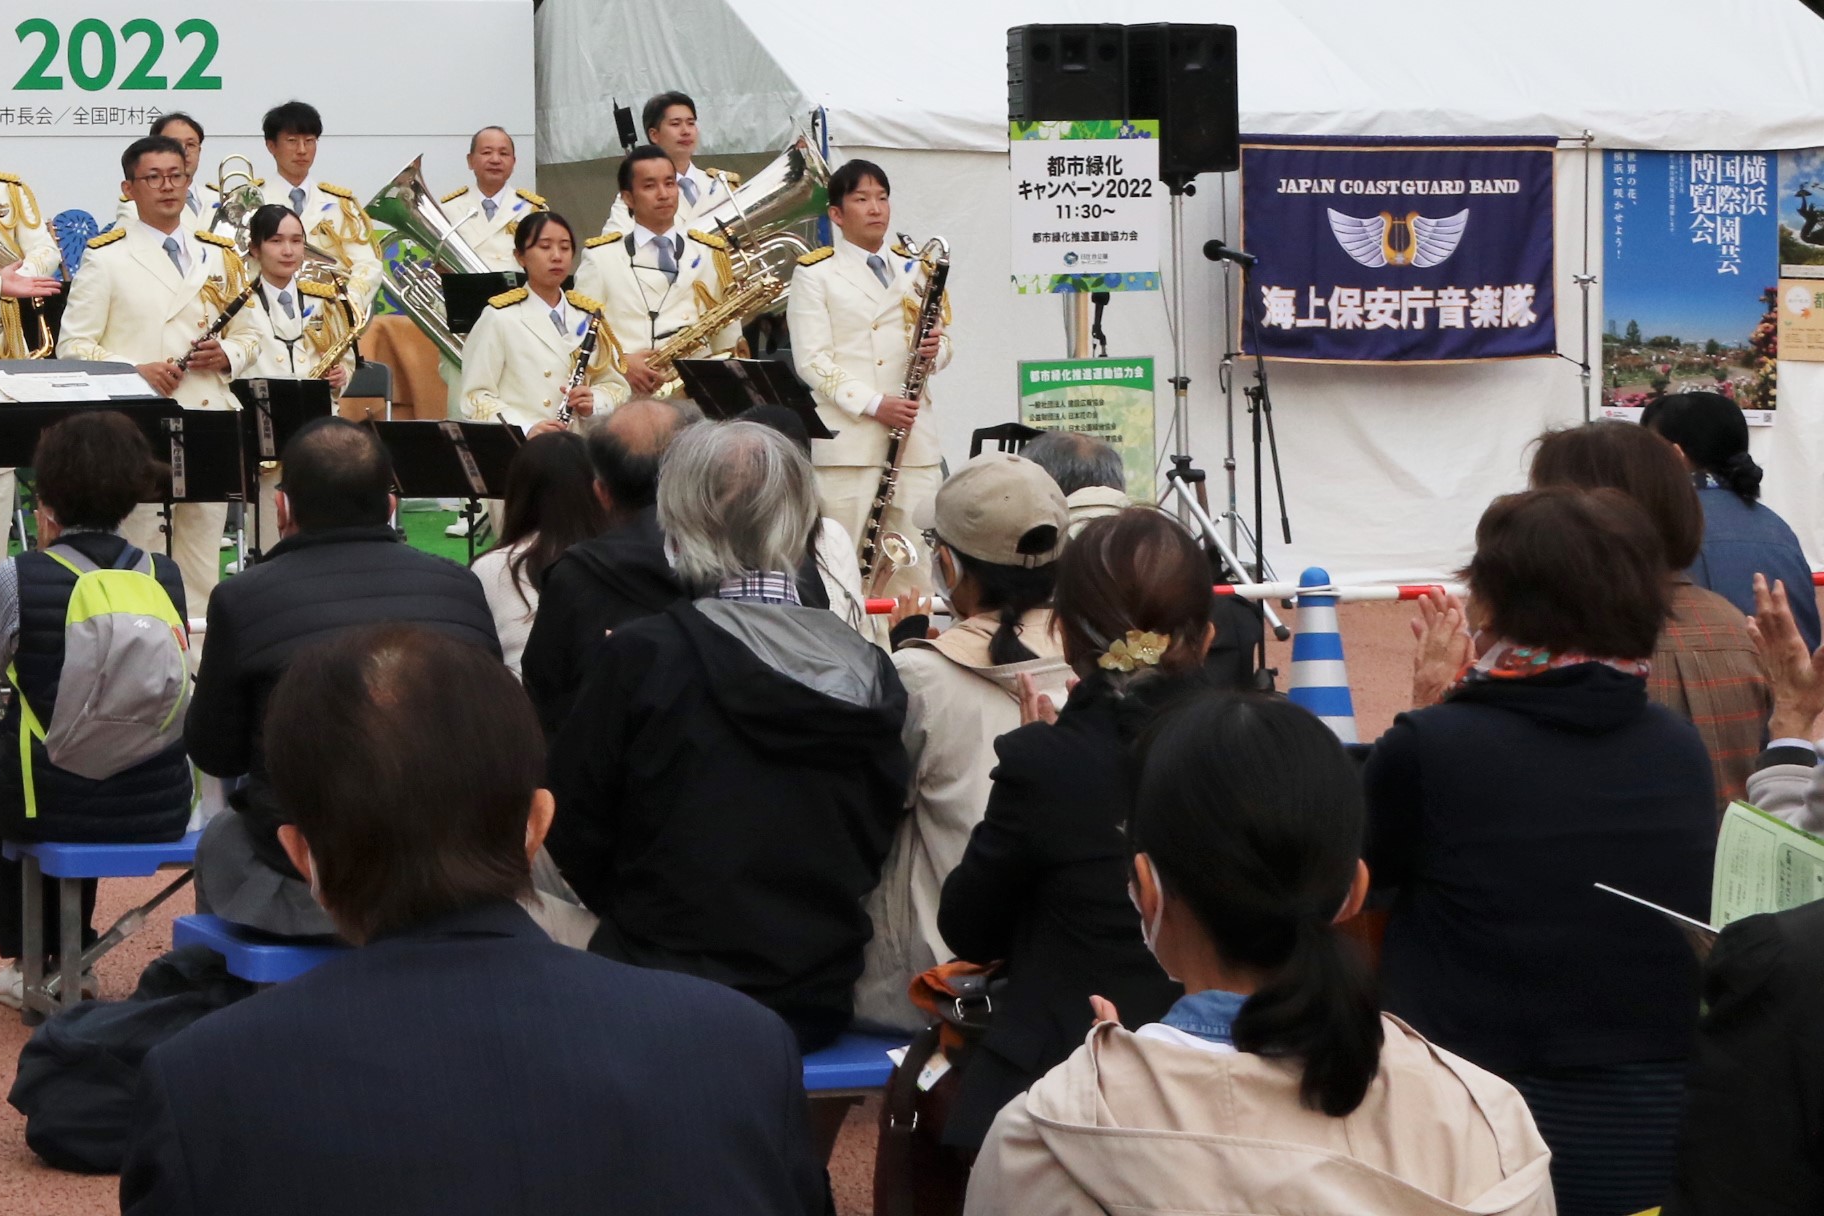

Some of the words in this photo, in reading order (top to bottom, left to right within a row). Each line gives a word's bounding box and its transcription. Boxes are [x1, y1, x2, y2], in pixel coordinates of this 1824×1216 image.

[12, 17, 223, 92] 2022
[1047, 155, 1123, 177] 都市緑化
[1018, 178, 1152, 201] キャンペーン2022
[1277, 179, 1336, 195] JAPAN
[1469, 179, 1520, 195] BAND
[1689, 152, 1716, 245] 博覧会
[1740, 154, 1768, 216] 横浜
[1715, 154, 1742, 275] 国際園芸
[1032, 230, 1138, 243] 都市緑化推進運動協力会
[1260, 284, 1538, 330] 海上保安庁音楽隊
[1030, 366, 1144, 383] 都市緑化推進運動協力会
